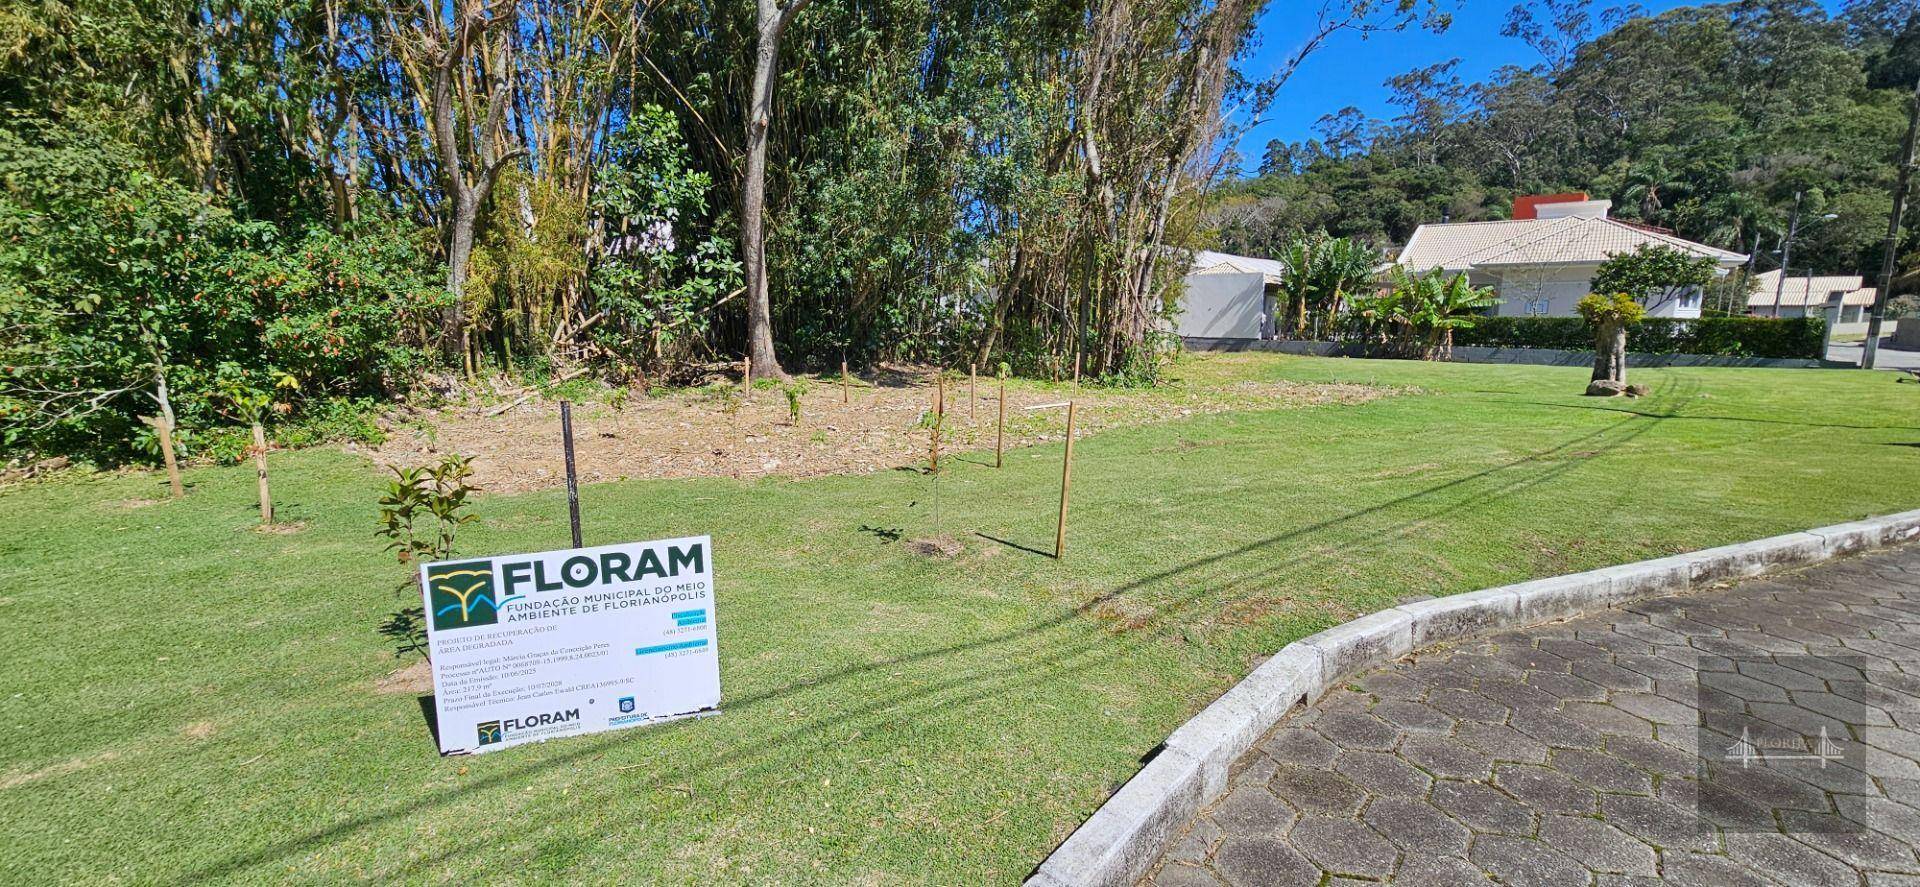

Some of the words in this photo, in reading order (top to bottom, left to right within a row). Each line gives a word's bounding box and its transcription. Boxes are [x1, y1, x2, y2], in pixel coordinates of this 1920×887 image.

[502, 543, 704, 596] FLORAM
[507, 596, 580, 613] FUNDAÇÃO
[584, 588, 651, 603] MUNICIPAL
[655, 585, 672, 595] DO
[676, 581, 706, 592] MEIO
[508, 606, 577, 622] AMBIENTE
[582, 603, 599, 614] DE
[604, 590, 706, 610] FLORIANÓPOLIS
[437, 636, 472, 646] PROJETO
[474, 633, 484, 641] DE
[487, 624, 545, 639] RECUPERAÇÃO
[547, 623, 558, 632] DE
[438, 645, 461, 655] ÁREA
[462, 639, 513, 652] DEGRADADA
[440, 660, 482, 671] Responsável
[440, 670, 471, 679] Processo
[442, 679, 458, 688] Data
[464, 692, 482, 701] Final
[503, 708, 580, 732] FLORAM
